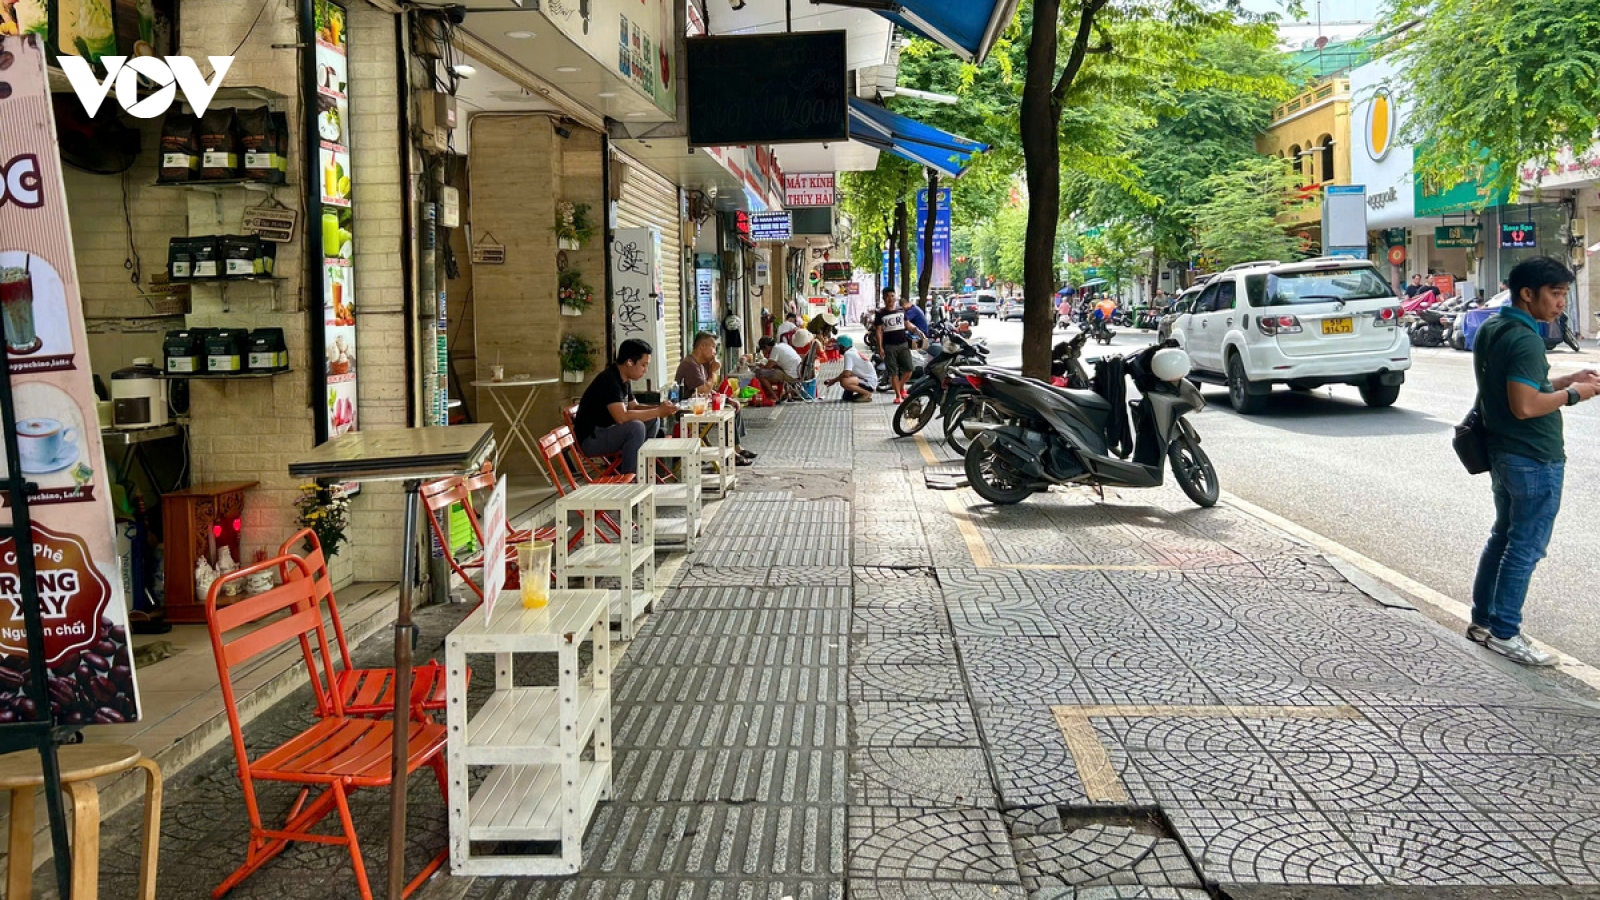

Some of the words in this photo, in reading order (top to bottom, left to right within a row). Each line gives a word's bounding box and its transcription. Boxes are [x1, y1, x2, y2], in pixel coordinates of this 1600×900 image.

[809, 174, 833, 188] KÍNH
[1520, 223, 1533, 232] Spa
[4, 551, 17, 565] C
[32, 542, 63, 563] Phê
[0, 572, 77, 596] RNG
[1, 626, 53, 642] Ngun
[55, 619, 86, 636] chất
